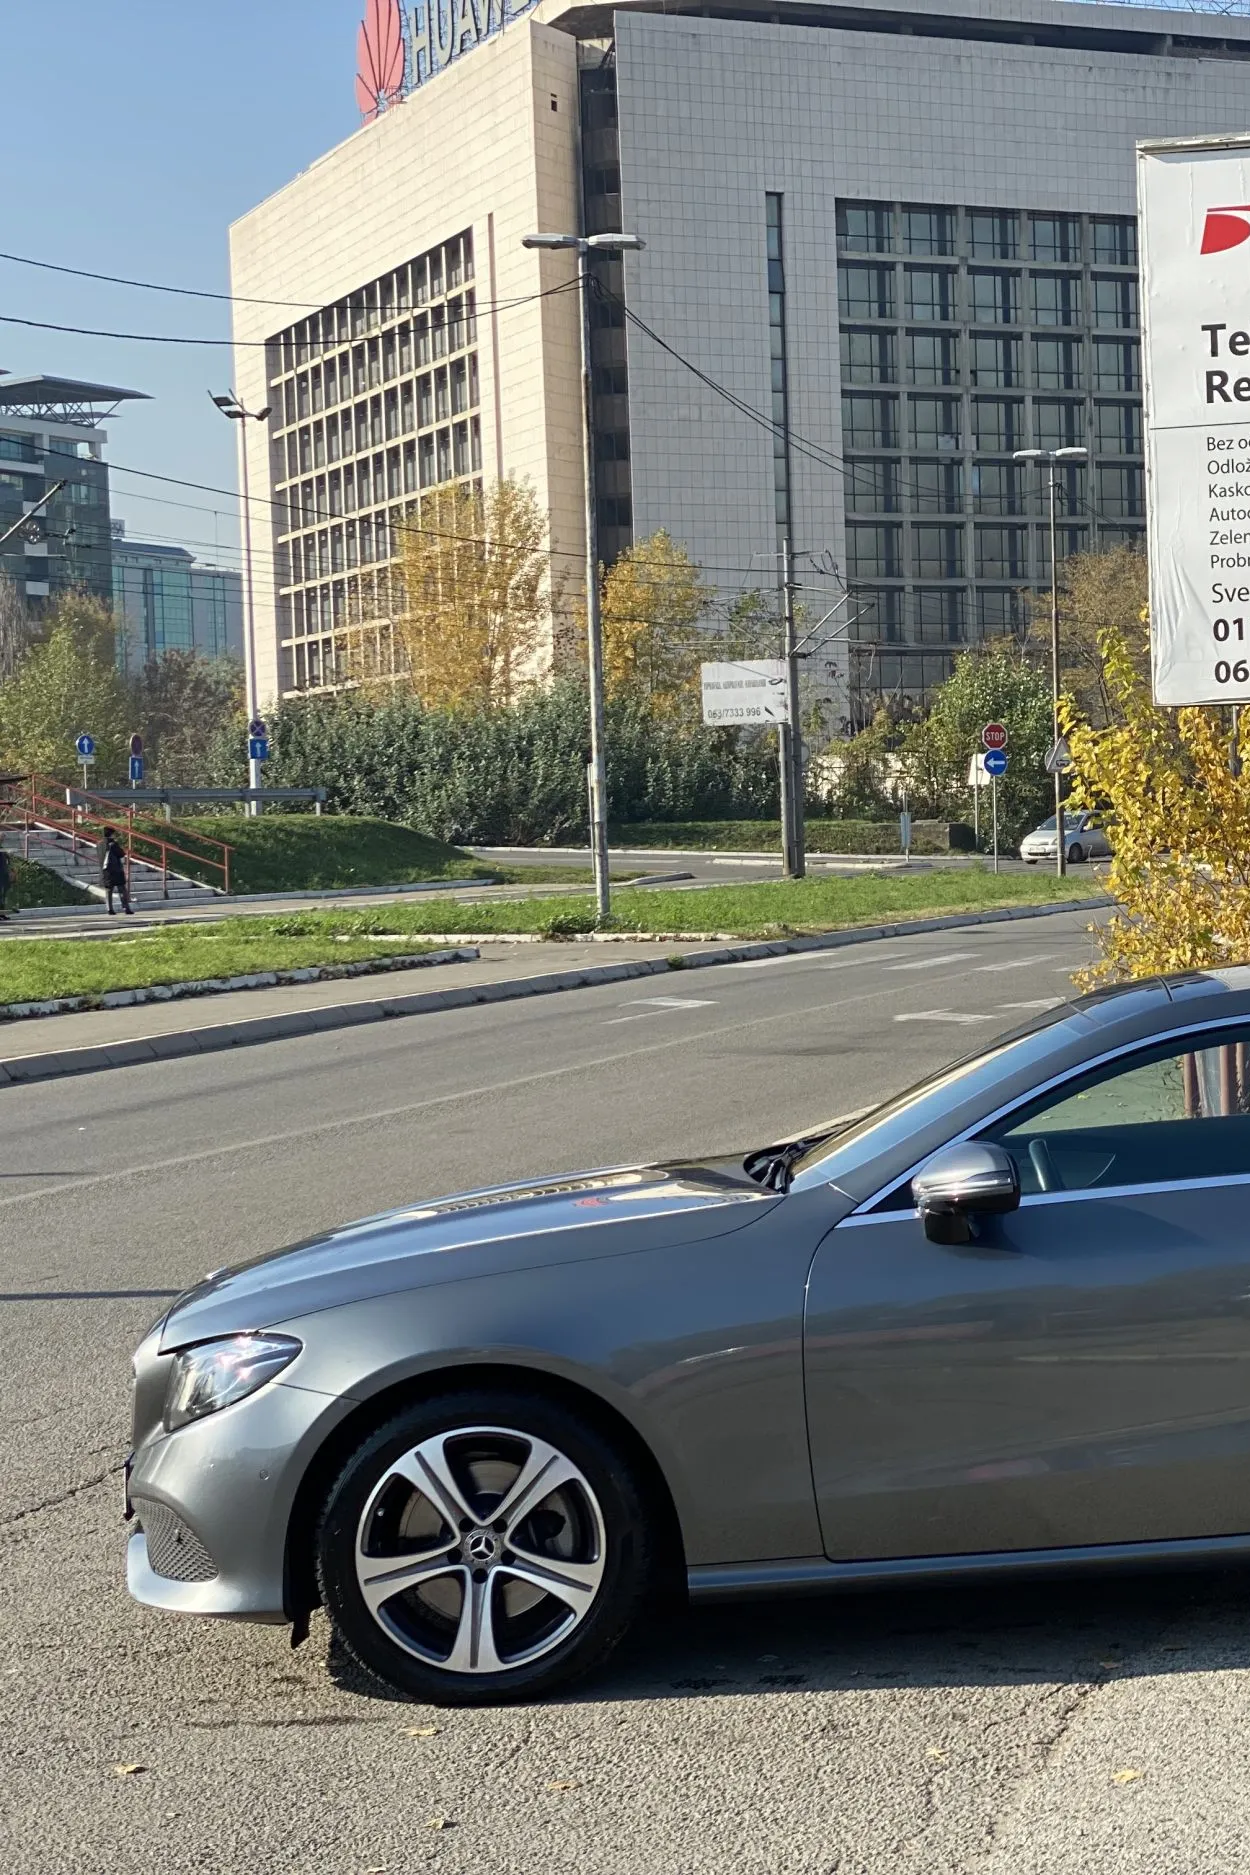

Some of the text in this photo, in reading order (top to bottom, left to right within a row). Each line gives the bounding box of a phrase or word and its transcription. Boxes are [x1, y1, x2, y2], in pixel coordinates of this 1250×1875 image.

[409, 0, 532, 85] HUAW
[1206, 435, 1234, 451] Bez
[1211, 582, 1250, 604] Sve
[986, 731, 1005, 741] STOP
